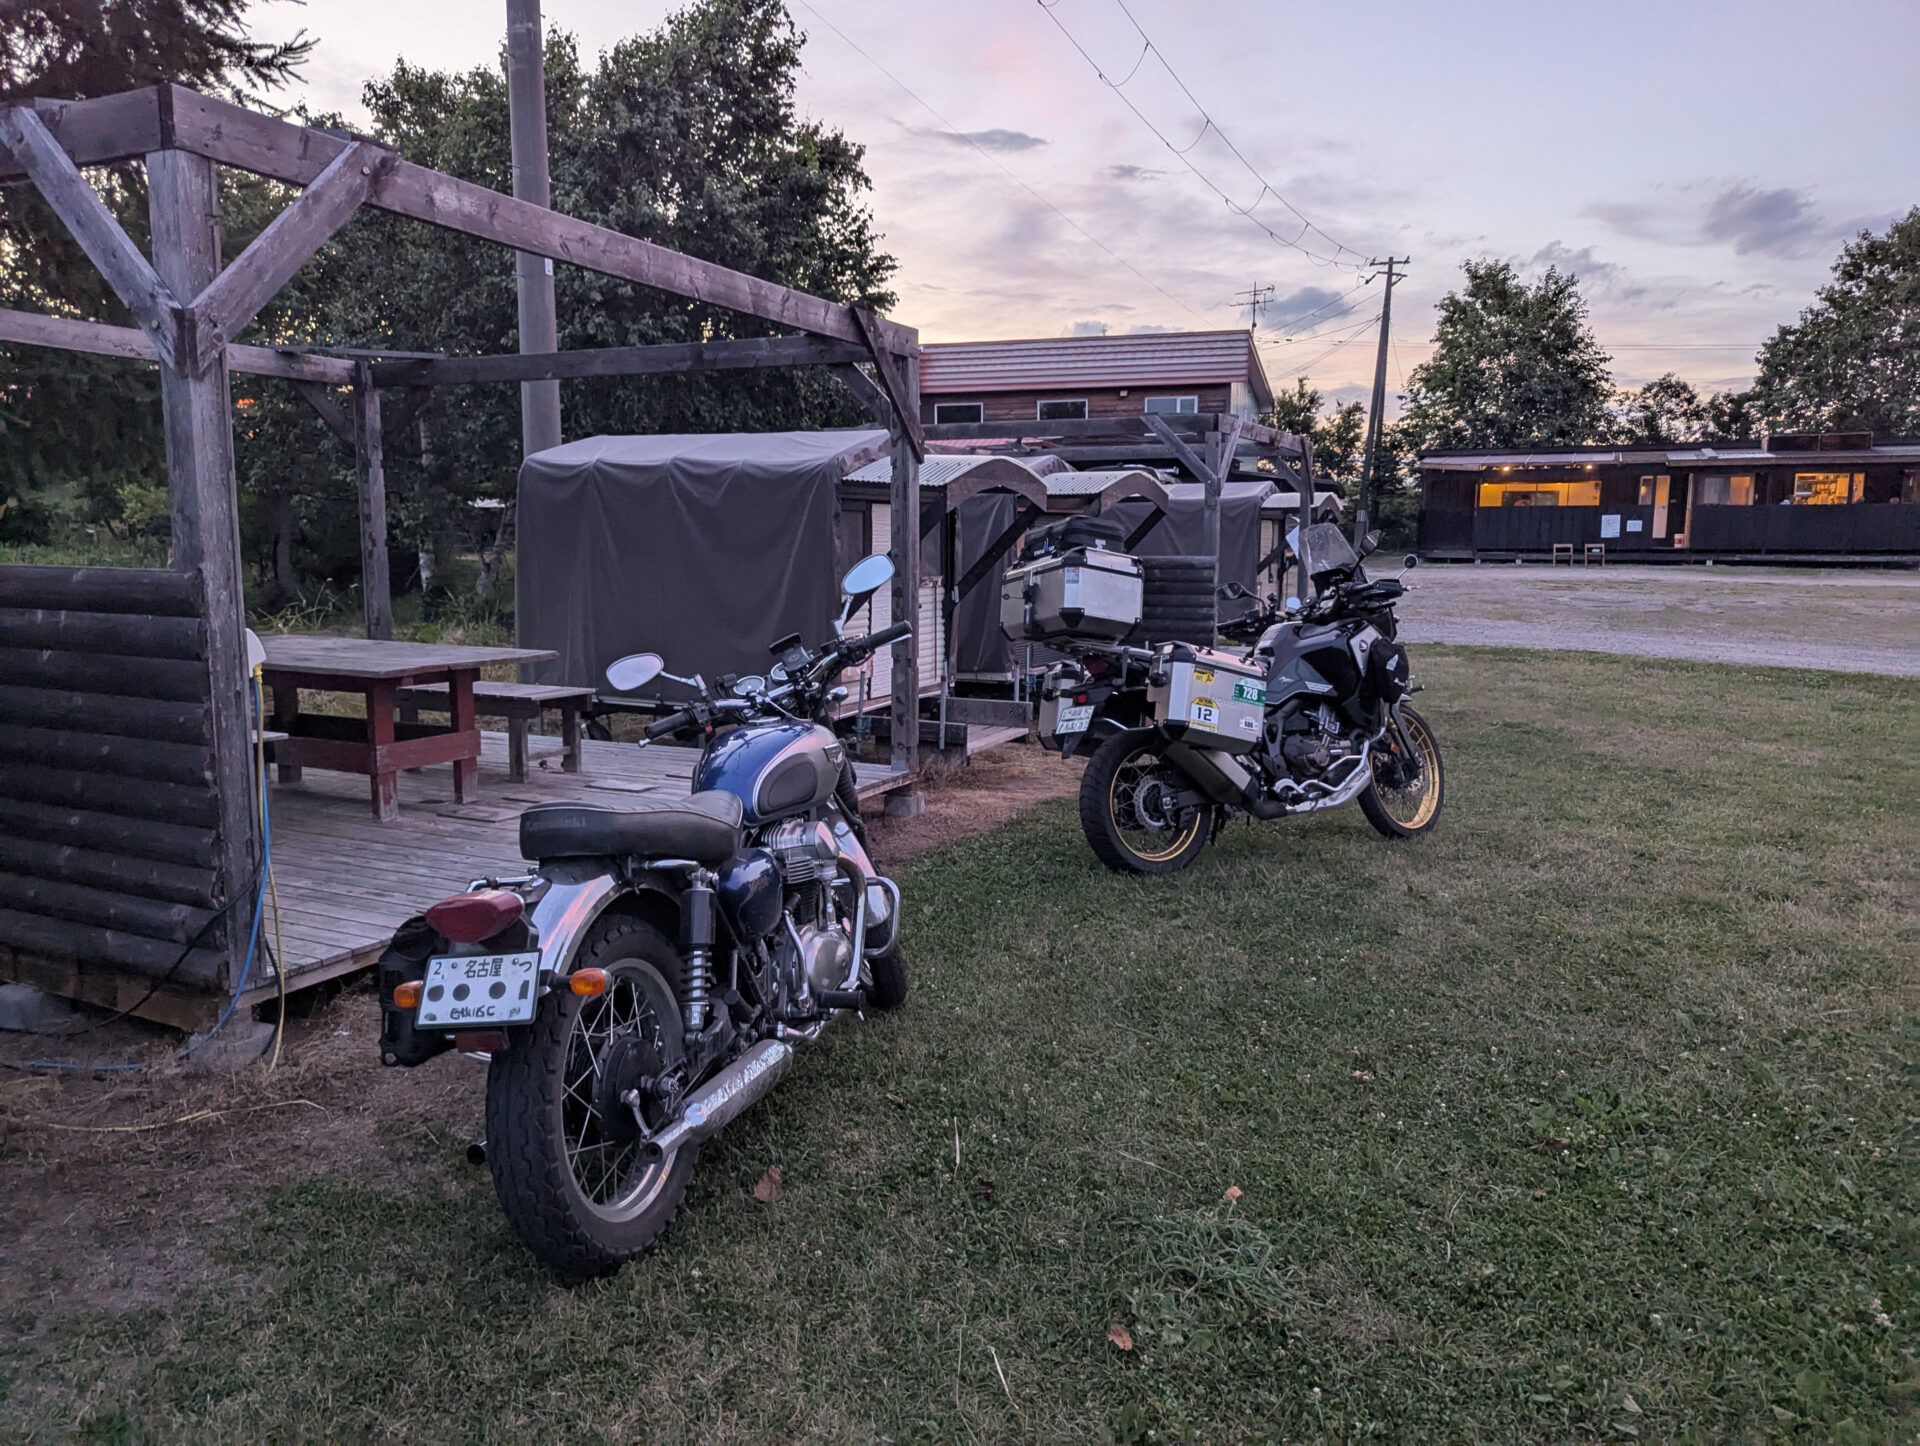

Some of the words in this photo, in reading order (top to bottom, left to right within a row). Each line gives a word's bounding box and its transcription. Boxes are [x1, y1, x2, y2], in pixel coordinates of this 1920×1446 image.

[1242, 686, 1259, 701] 728
[1197, 707, 1213, 721] 12
[464, 958, 503, 978] 名古屋
[518, 961, 533, 973] つ
